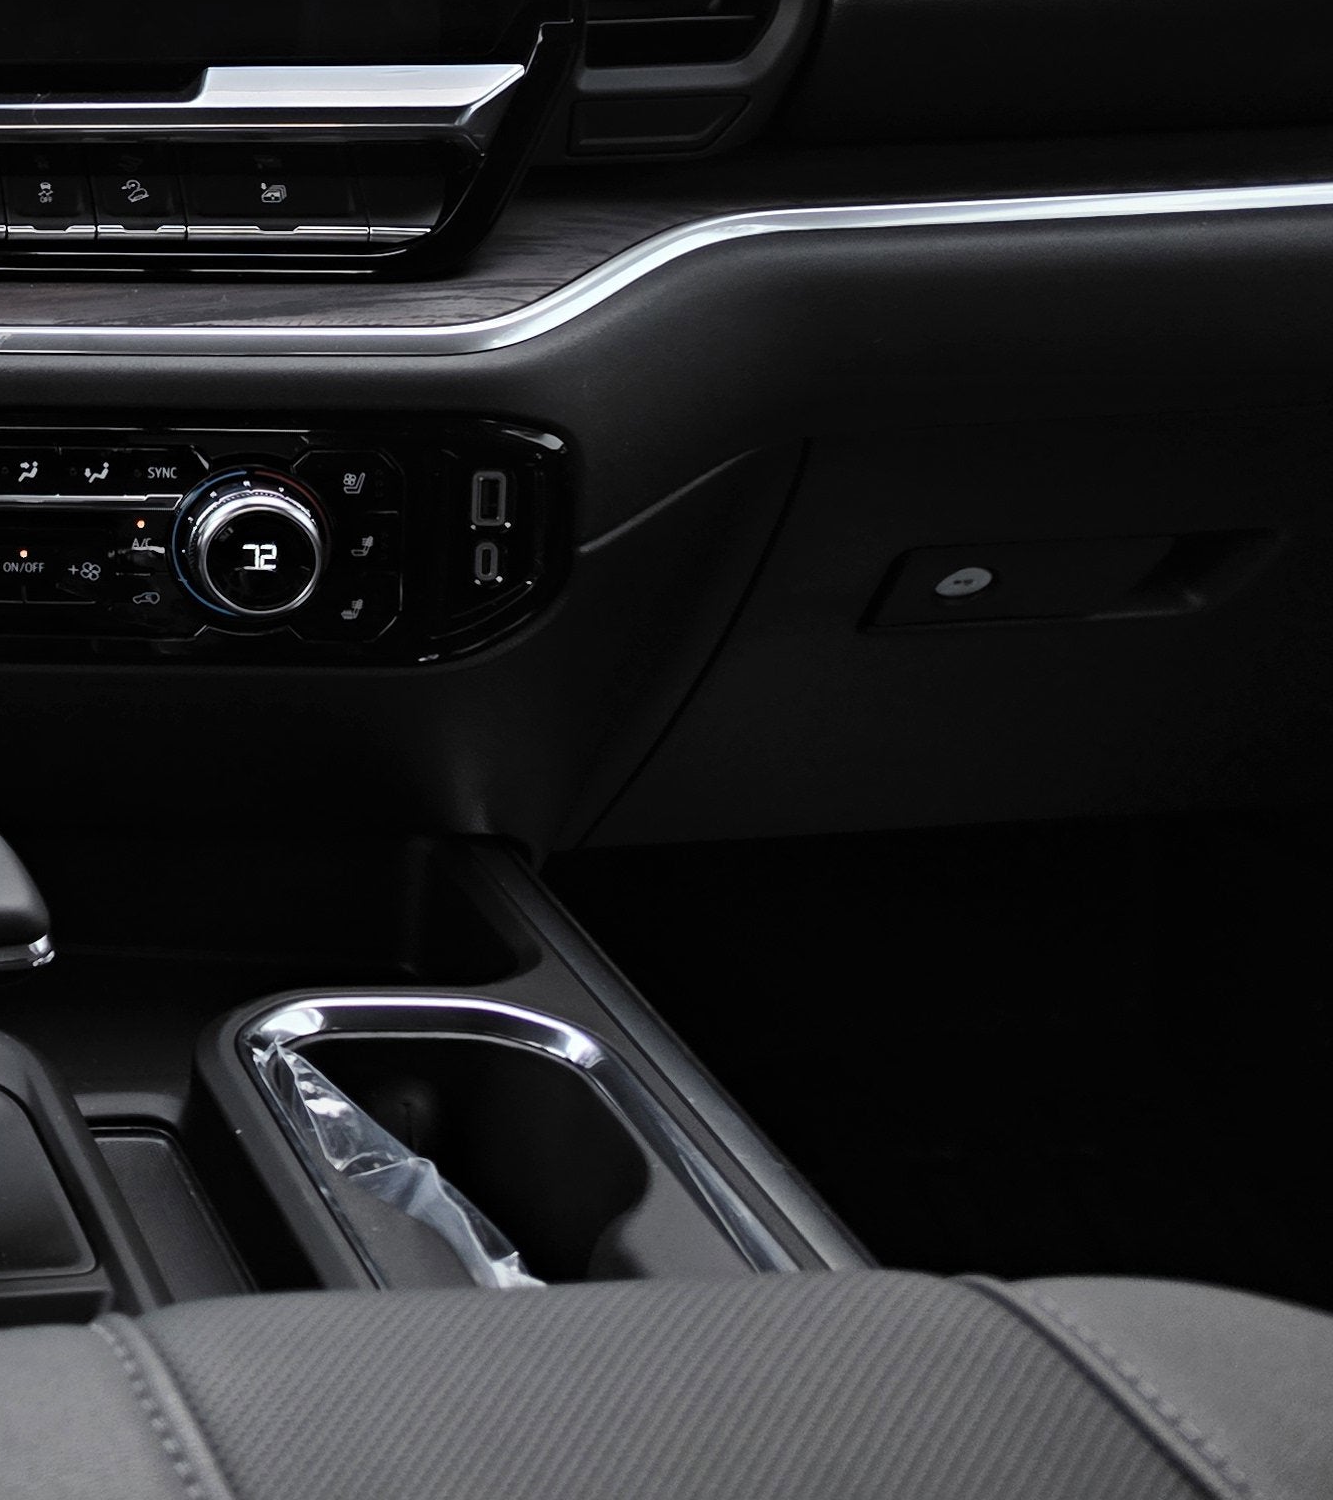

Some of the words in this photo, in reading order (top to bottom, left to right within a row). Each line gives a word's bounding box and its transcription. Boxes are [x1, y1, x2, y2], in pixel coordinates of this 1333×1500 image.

[147, 467, 179, 480] SYNC
[242, 544, 278, 571] 72
[2, 562, 45, 575] ON/OFF
